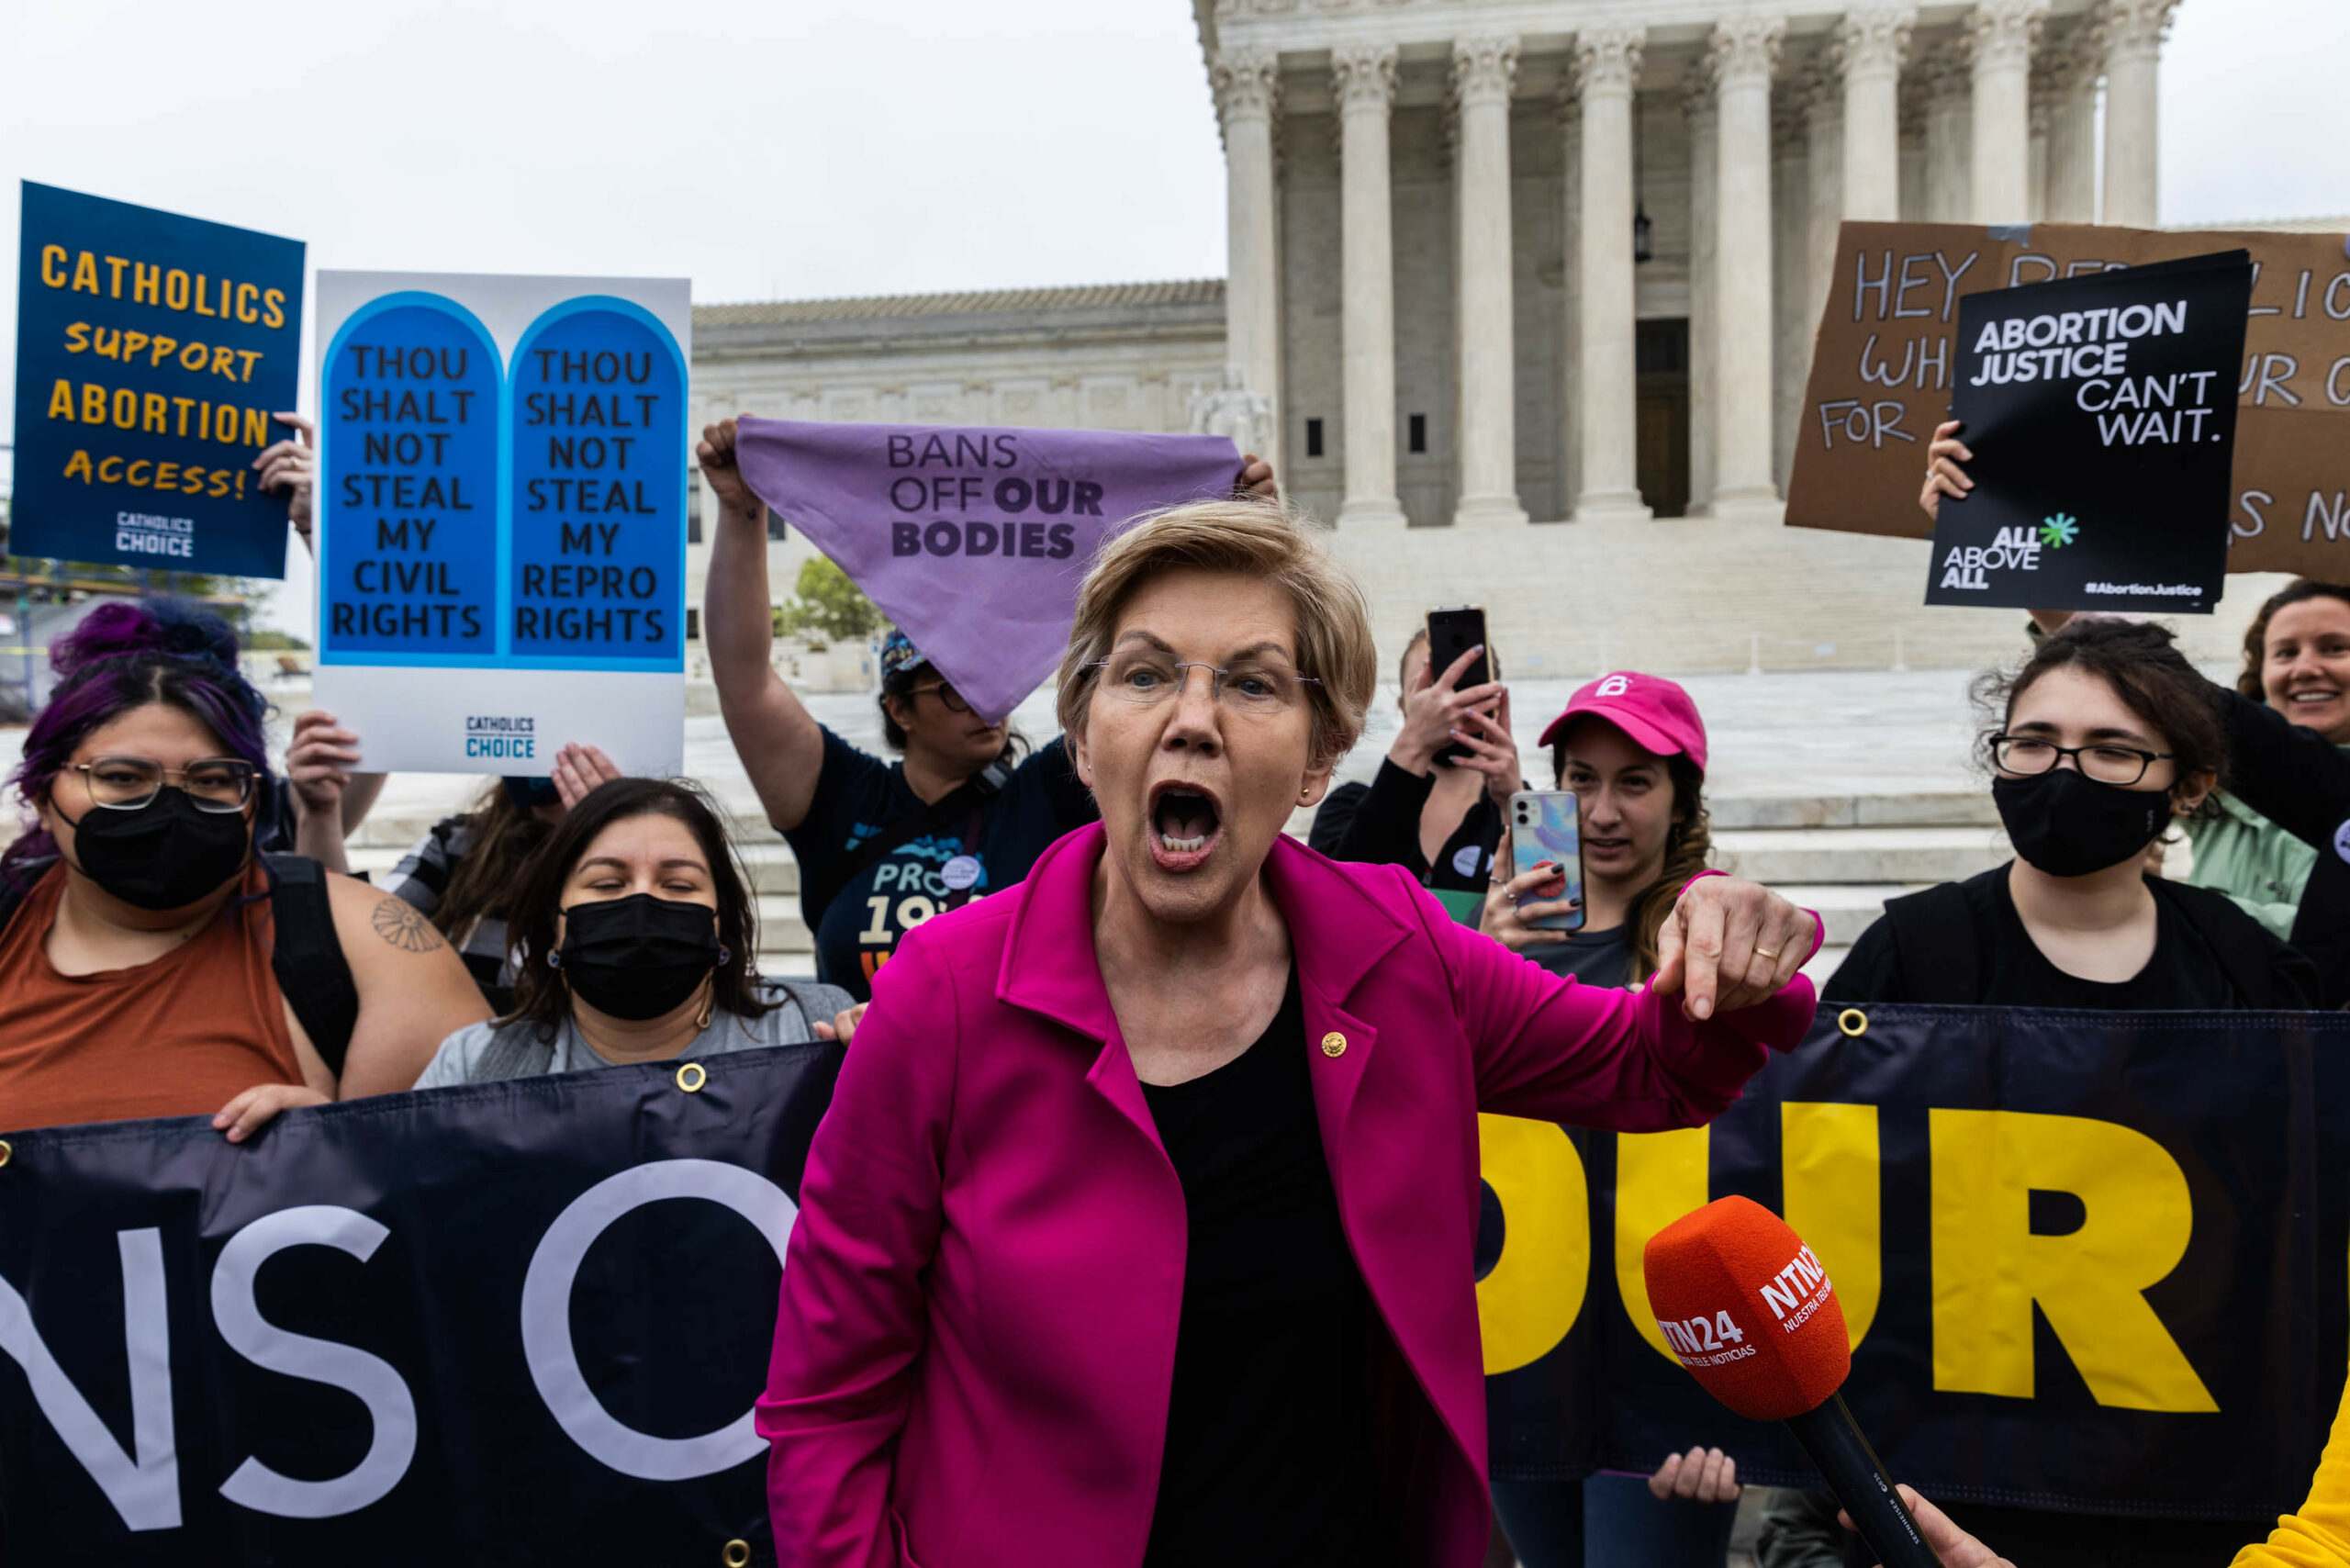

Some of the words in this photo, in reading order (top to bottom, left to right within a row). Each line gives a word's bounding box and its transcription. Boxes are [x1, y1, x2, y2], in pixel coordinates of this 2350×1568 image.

[41, 243, 286, 330] CATHOLICS
[1854, 250, 1978, 321] HEY
[1973, 300, 2187, 353] ABORTION
[63, 321, 264, 384] SUPPORT
[349, 345, 468, 381] THOU
[534, 349, 652, 385] THOU
[1859, 333, 1953, 390] WH
[1970, 342, 2129, 387] JUSTICE
[341, 387, 476, 424] SHALT
[2076, 370, 2218, 413] CAN'T
[47, 379, 269, 448] ABORTION
[525, 392, 660, 429] SHALT
[1818, 398, 1917, 450] FOR
[2096, 408, 2221, 447] WAIT.
[364, 431, 452, 467] NOT
[548, 436, 635, 471] NOT
[888, 433, 1018, 469] BANS
[63, 449, 247, 501] ACCESS!
[343, 475, 473, 510] STEAL
[527, 479, 656, 514] STEAL
[890, 476, 984, 512] OFF
[993, 476, 1104, 516] OUR
[117, 510, 195, 533] CATHOLICS
[376, 518, 437, 552] MY
[561, 522, 621, 556] MY
[1991, 526, 2042, 549] ALL
[116, 532, 194, 558] CHOICE
[891, 521, 1075, 560] BODIES
[1943, 546, 2041, 570] ABOVE
[353, 560, 461, 596] CIVIL
[523, 565, 657, 599] REPRO
[1940, 566, 1989, 590] ALL
[2084, 582, 2203, 597] #AbortionJustice
[332, 602, 482, 639] RIGHTS
[516, 607, 665, 644] RIGHTS
[465, 715, 535, 733] CATHOLICS
[465, 738, 535, 759] CHOICE
[1783, 1298, 1820, 1334] NUESTRA
[1708, 1344, 1756, 1367] NOTICIAS
[1889, 1498, 1920, 1545] SENNHEISER
